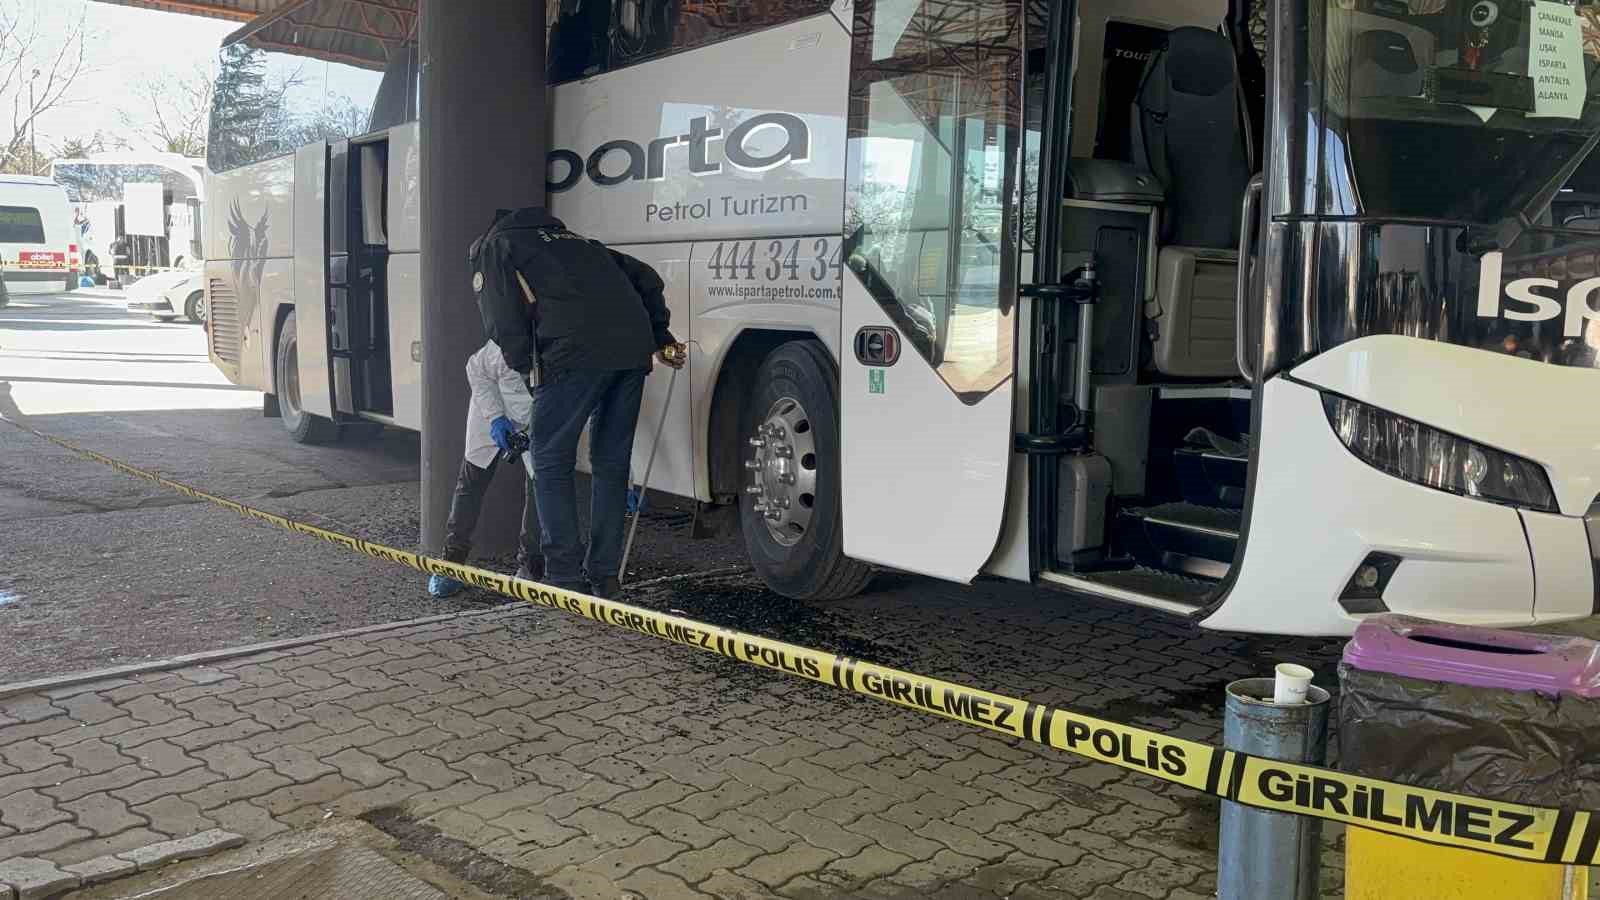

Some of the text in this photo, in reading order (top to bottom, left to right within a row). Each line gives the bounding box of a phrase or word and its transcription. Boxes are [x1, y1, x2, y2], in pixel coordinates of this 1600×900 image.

[1538, 74, 1570, 87] ANTALYA
[1538, 90, 1568, 101] ALANYA
[646, 194, 808, 222] Petrol Turizm
[707, 238, 843, 281] 444 34 34
